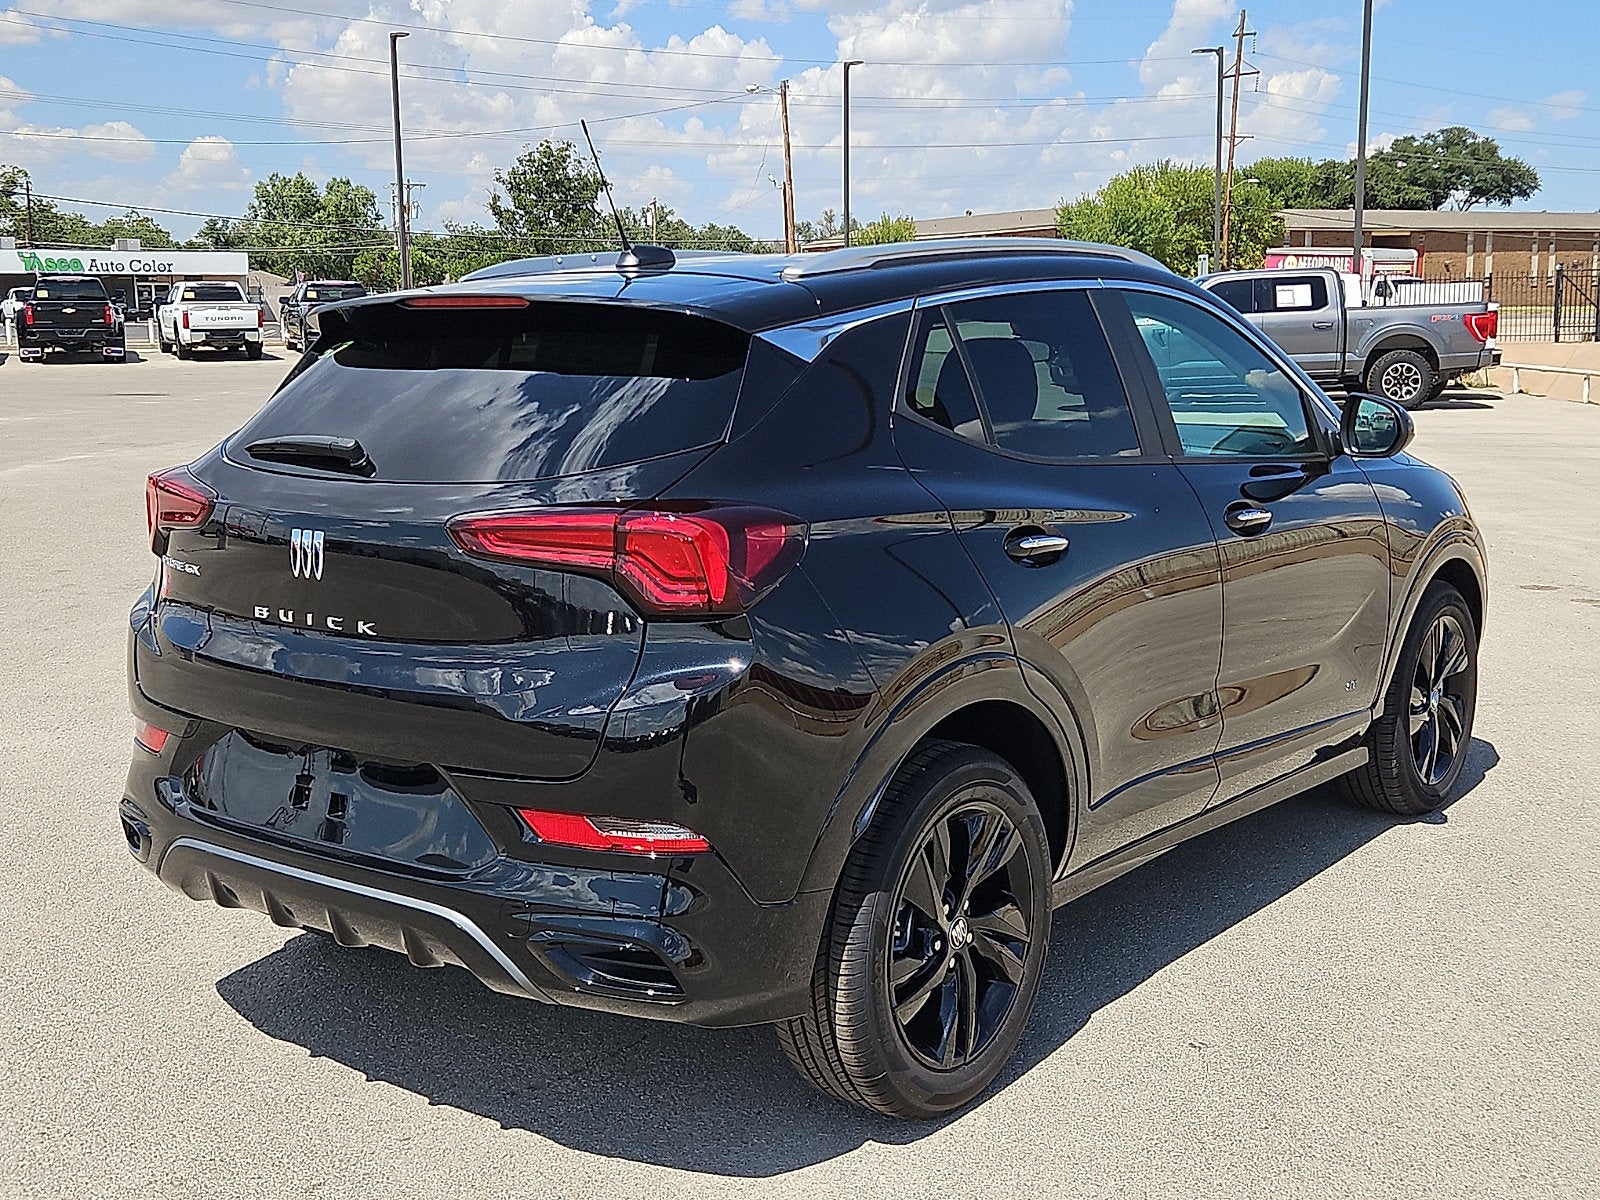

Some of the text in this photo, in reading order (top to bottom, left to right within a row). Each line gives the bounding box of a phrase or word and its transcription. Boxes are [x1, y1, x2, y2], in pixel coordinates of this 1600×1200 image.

[88, 259, 125, 273] Auto
[129, 259, 173, 272] Color
[1297, 256, 1351, 273] AFFORDABLE
[185, 563, 201, 577] GX
[254, 605, 377, 636] BUICK
